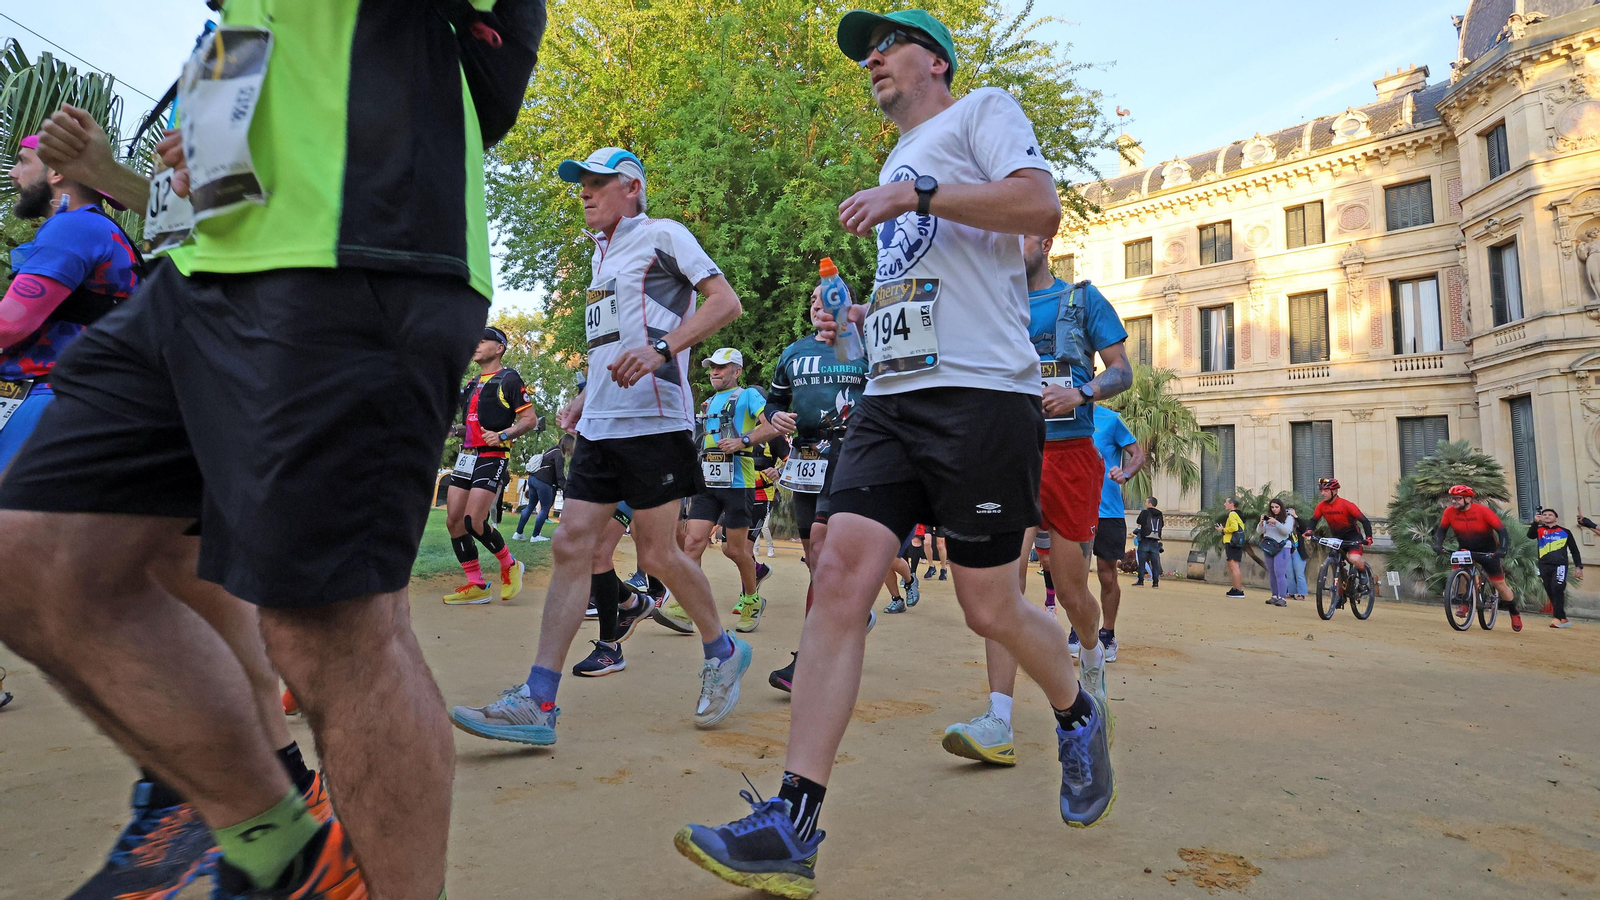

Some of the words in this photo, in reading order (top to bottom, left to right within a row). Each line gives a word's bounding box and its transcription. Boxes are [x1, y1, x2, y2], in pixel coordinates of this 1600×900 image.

[826, 287, 841, 306] G
[587, 305, 601, 329] 40
[872, 307, 911, 347] 194
[792, 355, 822, 377] VII
[820, 364, 863, 374] CARRERA
[810, 376, 820, 385] DE
[823, 375, 833, 384] LA
[709, 464, 722, 476] 25
[796, 461, 817, 478] 183
